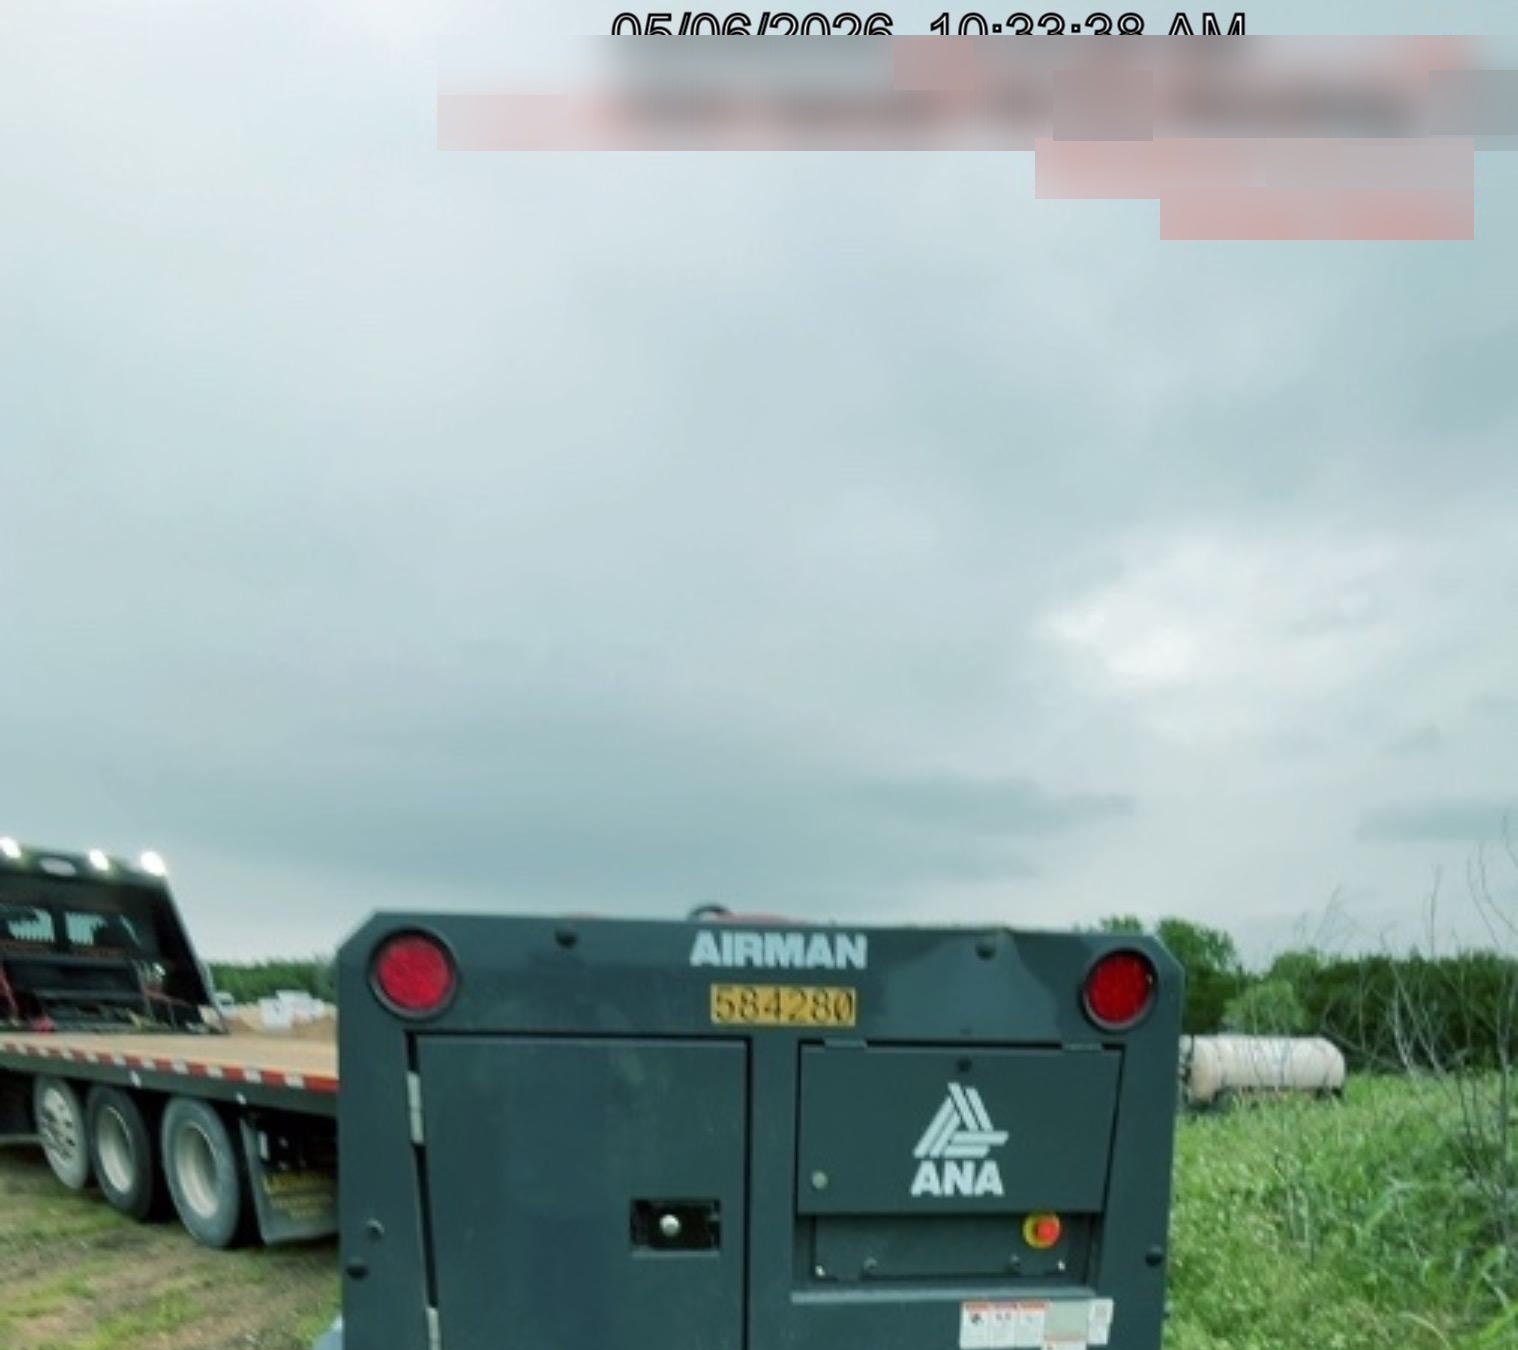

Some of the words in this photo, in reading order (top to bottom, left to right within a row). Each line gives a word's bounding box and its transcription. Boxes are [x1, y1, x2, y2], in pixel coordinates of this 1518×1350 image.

[690, 929, 868, 969] AIRMAN
[714, 985, 854, 1023] 584280
[911, 1160, 1004, 1196] ANA
